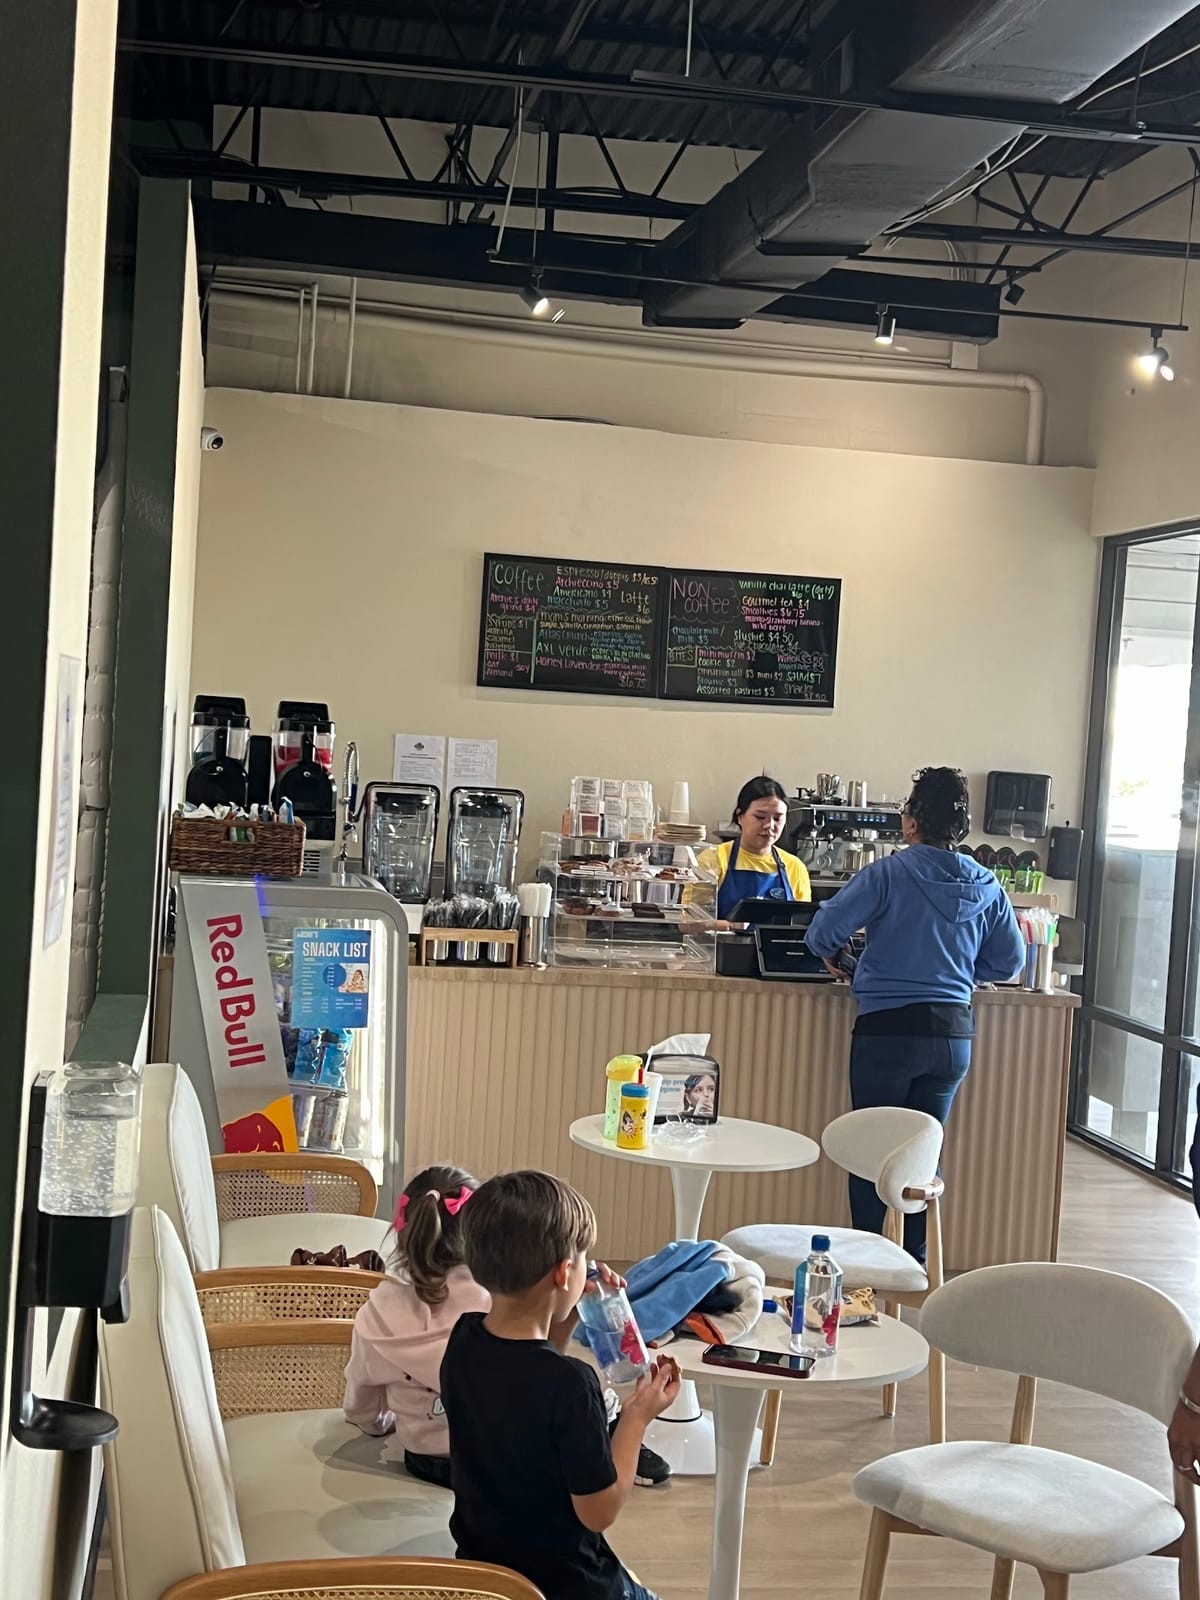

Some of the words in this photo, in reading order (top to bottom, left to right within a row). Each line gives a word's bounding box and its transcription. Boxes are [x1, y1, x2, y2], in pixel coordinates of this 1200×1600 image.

[494, 563, 545, 593] Coffee
[621, 591, 650, 606] Latte
[206, 914, 254, 991] Red
[303, 941, 340, 957] SNACK
[343, 942, 368, 958] LIST
[219, 993, 267, 1069] Bull
